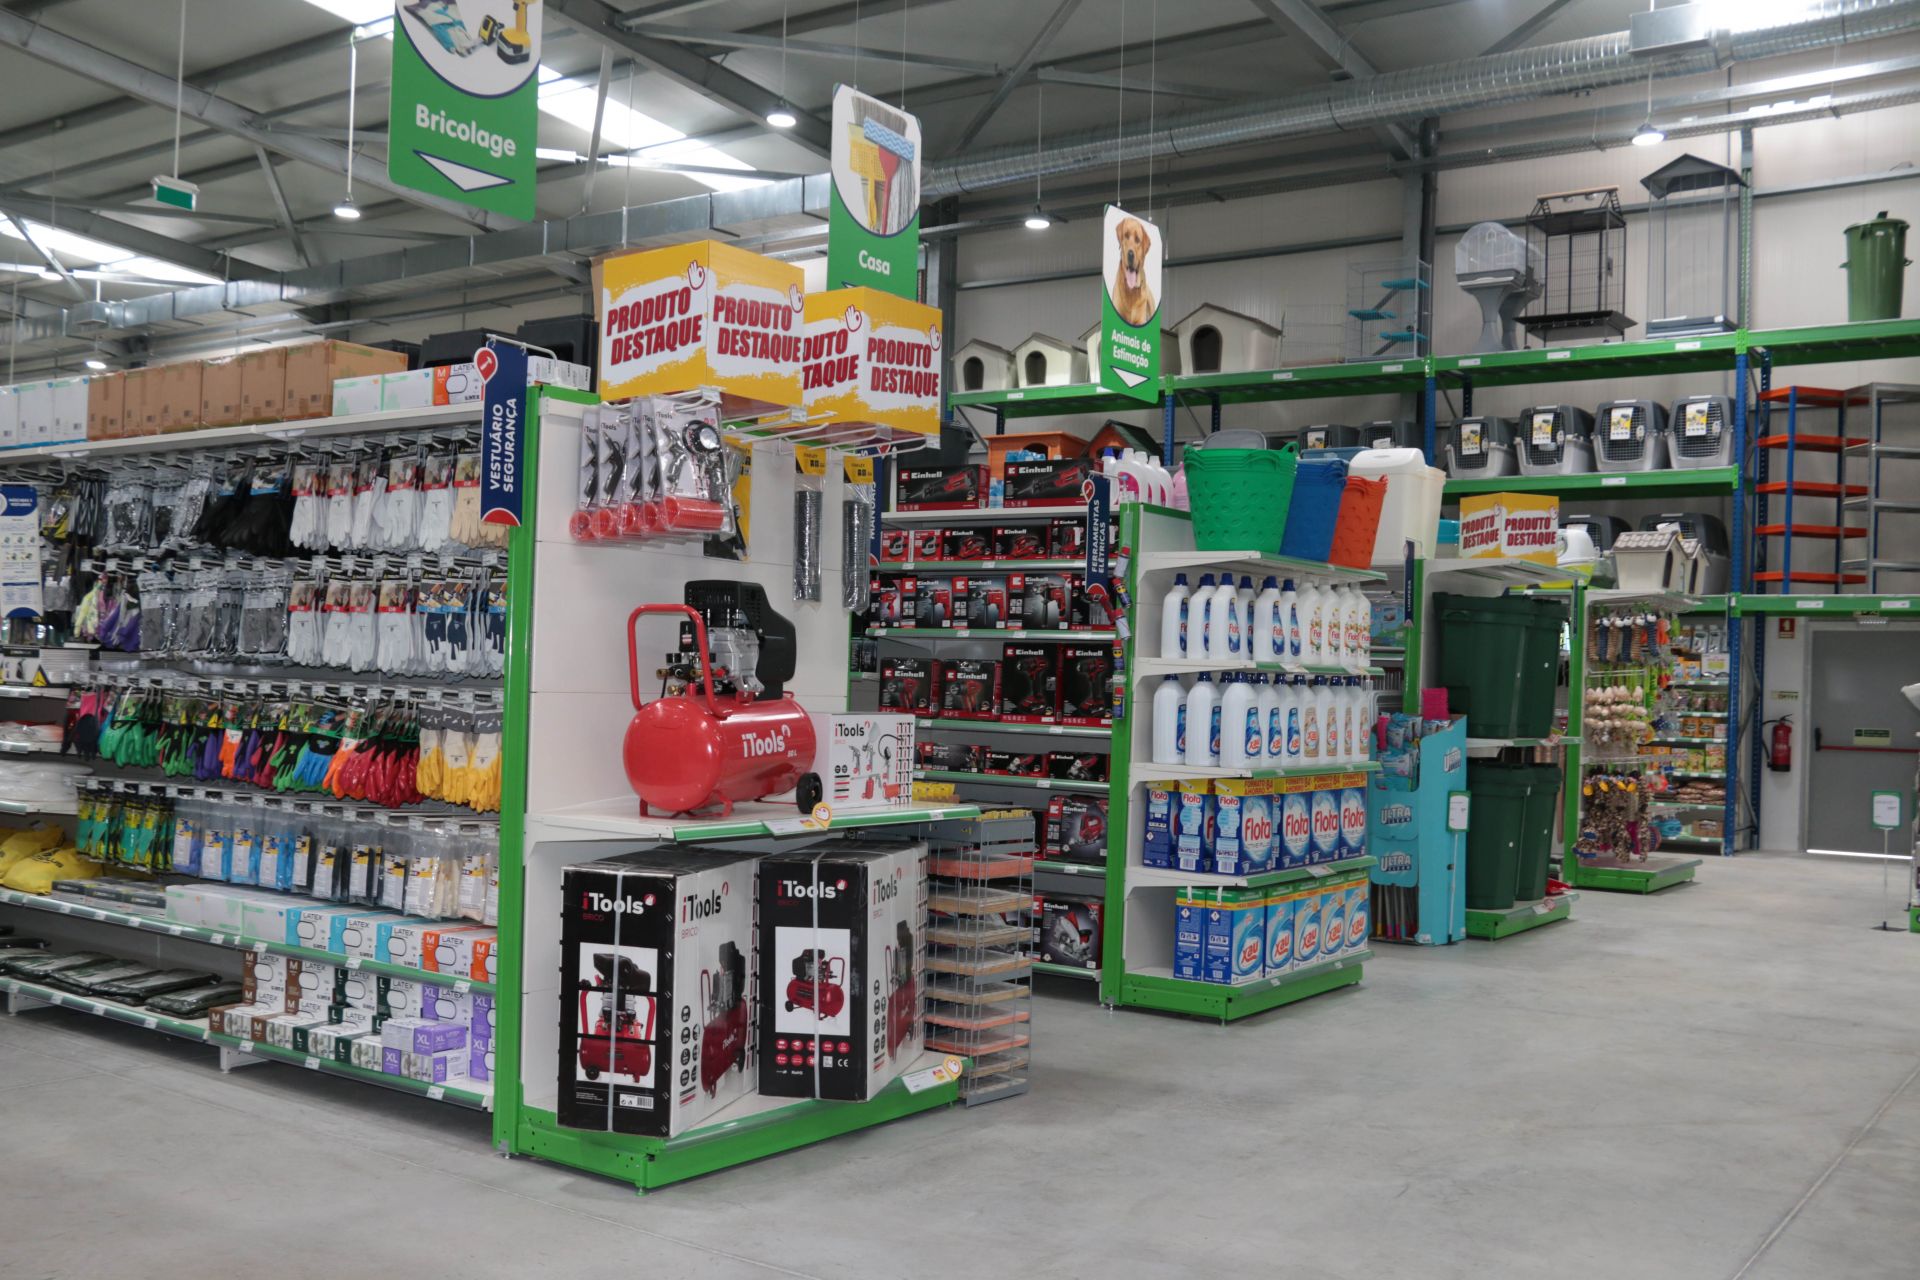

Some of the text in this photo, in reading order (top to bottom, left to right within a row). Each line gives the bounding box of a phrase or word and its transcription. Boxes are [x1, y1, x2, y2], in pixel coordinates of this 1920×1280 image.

[415, 103, 517, 158] Bricolage
[858, 249, 891, 276] Casa
[606, 286, 692, 337] PRODUTO
[712, 294, 793, 332] PRODUTO
[610, 314, 703, 366] DESTAQUE
[717, 327, 801, 364] DESTAQUE
[1111, 328, 1151, 354] Animais de
[866, 337, 932, 369] PRODUTO
[1112, 345, 1149, 368] Estimação
[870, 366, 940, 398] DESTAQUE
[489, 402, 504, 490] VESTUÁRIO
[503, 398, 518, 493] SEGURANÇA
[911, 471, 943, 479] Einhell
[1018, 465, 1053, 474] Einhell
[1461, 514, 1495, 535] PRODUTO
[1504, 517, 1551, 531] PRODUTO
[1091, 499, 1100, 573] FERRAMENTAS
[1463, 528, 1499, 549] DESTAQUE
[1506, 531, 1557, 546] DESTAQUE
[1015, 648, 1044, 656] Einhell
[893, 670, 925, 678] Einhell
[956, 672, 988, 680] Einhell
[834, 723, 865, 737] iTools
[742, 729, 786, 758] iTools
[1381, 806, 1411, 824] ULTRA
[1381, 855, 1411, 872] ULTRA
[777, 879, 836, 899] iTools
[873, 876, 898, 906] iTools
[582, 891, 644, 915] iTools
[682, 889, 722, 924] iTools
[393, 928, 415, 937] LATEX
[426, 935, 435, 944] M
[441, 936, 464, 945] LATEX
[476, 944, 485, 953] M
[245, 953, 254, 961] M
[289, 961, 298, 969] M
[244, 990, 253, 999] M
[424, 986, 436, 997] XL
[287, 1000, 295, 1008] M
[475, 997, 487, 1007] XL
[212, 1013, 220, 1021] M
[331, 1009, 338, 1019] L
[254, 1022, 262, 1030] M
[297, 1032, 302, 1042] L
[416, 1034, 430, 1045] XL
[339, 1042, 345, 1052] L
[472, 1039, 485, 1050] XL
[385, 1052, 398, 1063] XL
